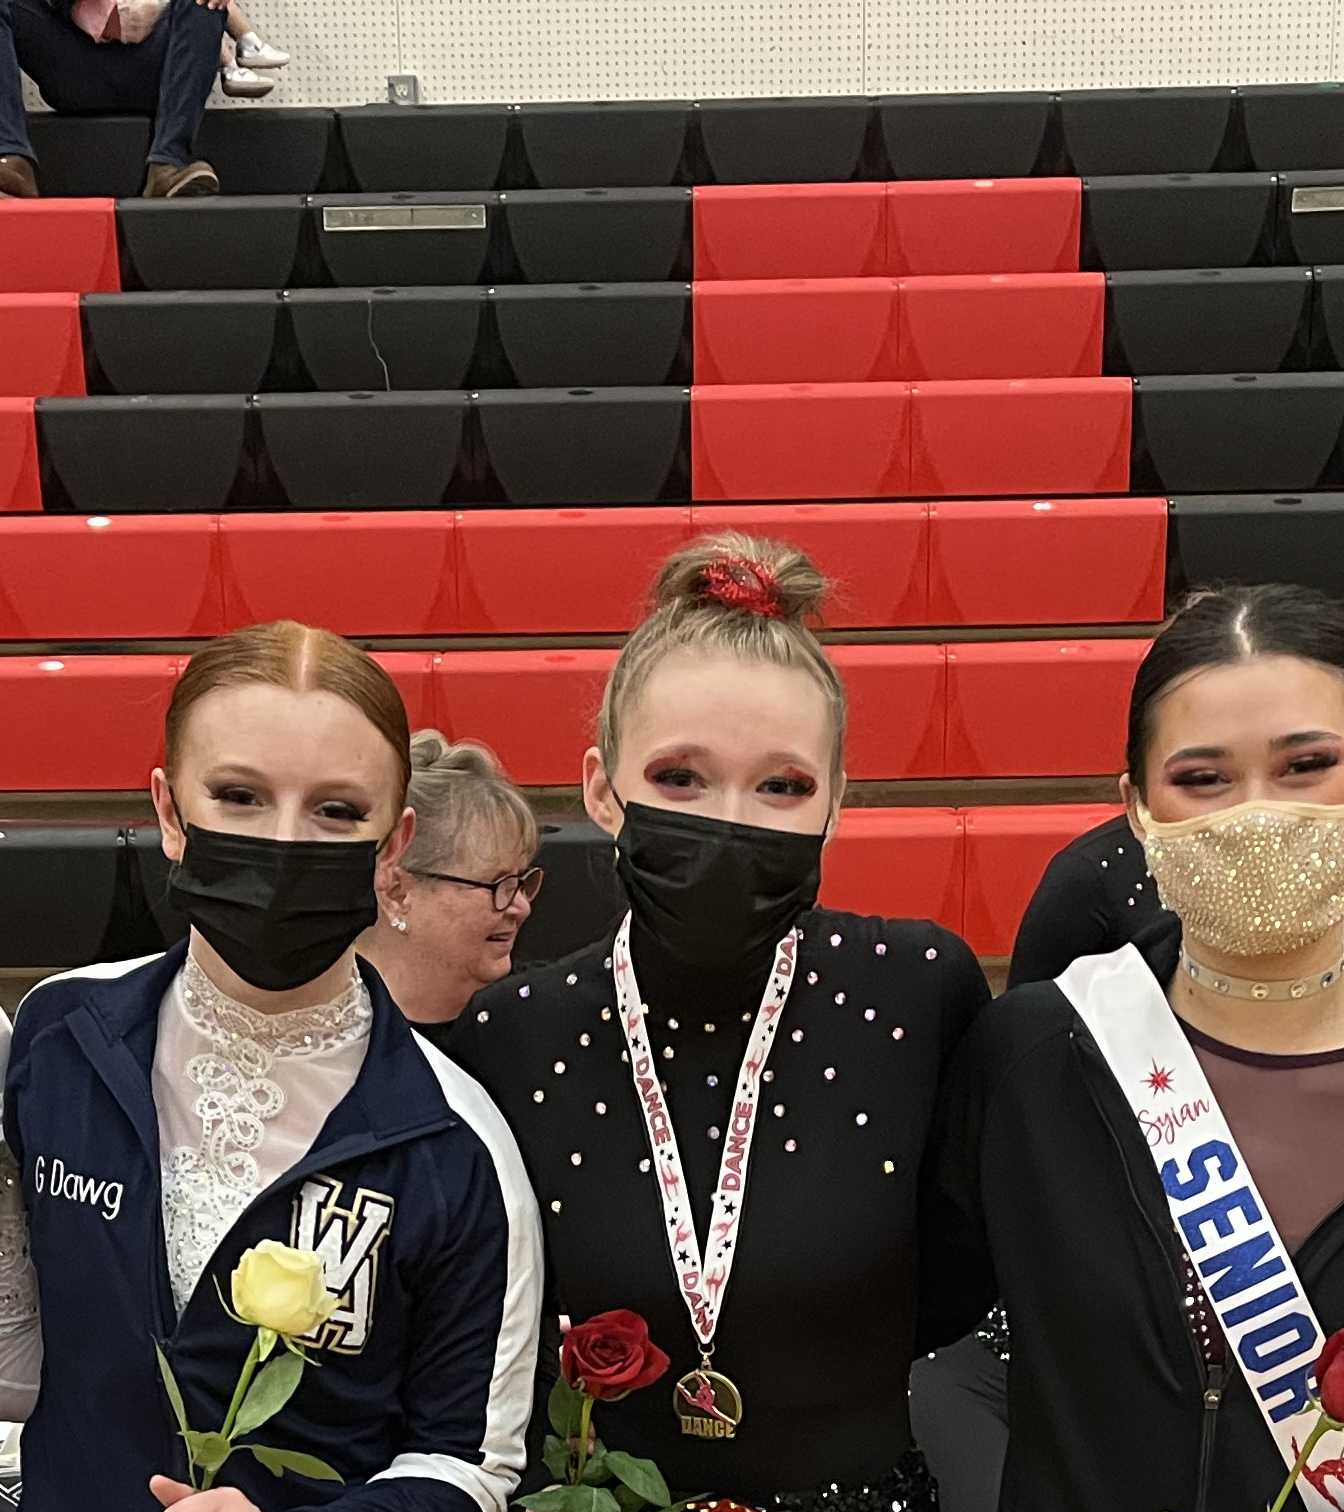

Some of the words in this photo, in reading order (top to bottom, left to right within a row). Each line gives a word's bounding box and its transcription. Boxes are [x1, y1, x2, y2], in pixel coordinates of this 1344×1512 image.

[636, 1056, 672, 1147] DANCE
[35, 1155, 45, 1193] G
[50, 1158, 124, 1221] Dawg
[721, 1102, 754, 1192] DANCE
[1160, 1138, 1326, 1424] SENIOR
[681, 1416, 736, 1439] DANCE
